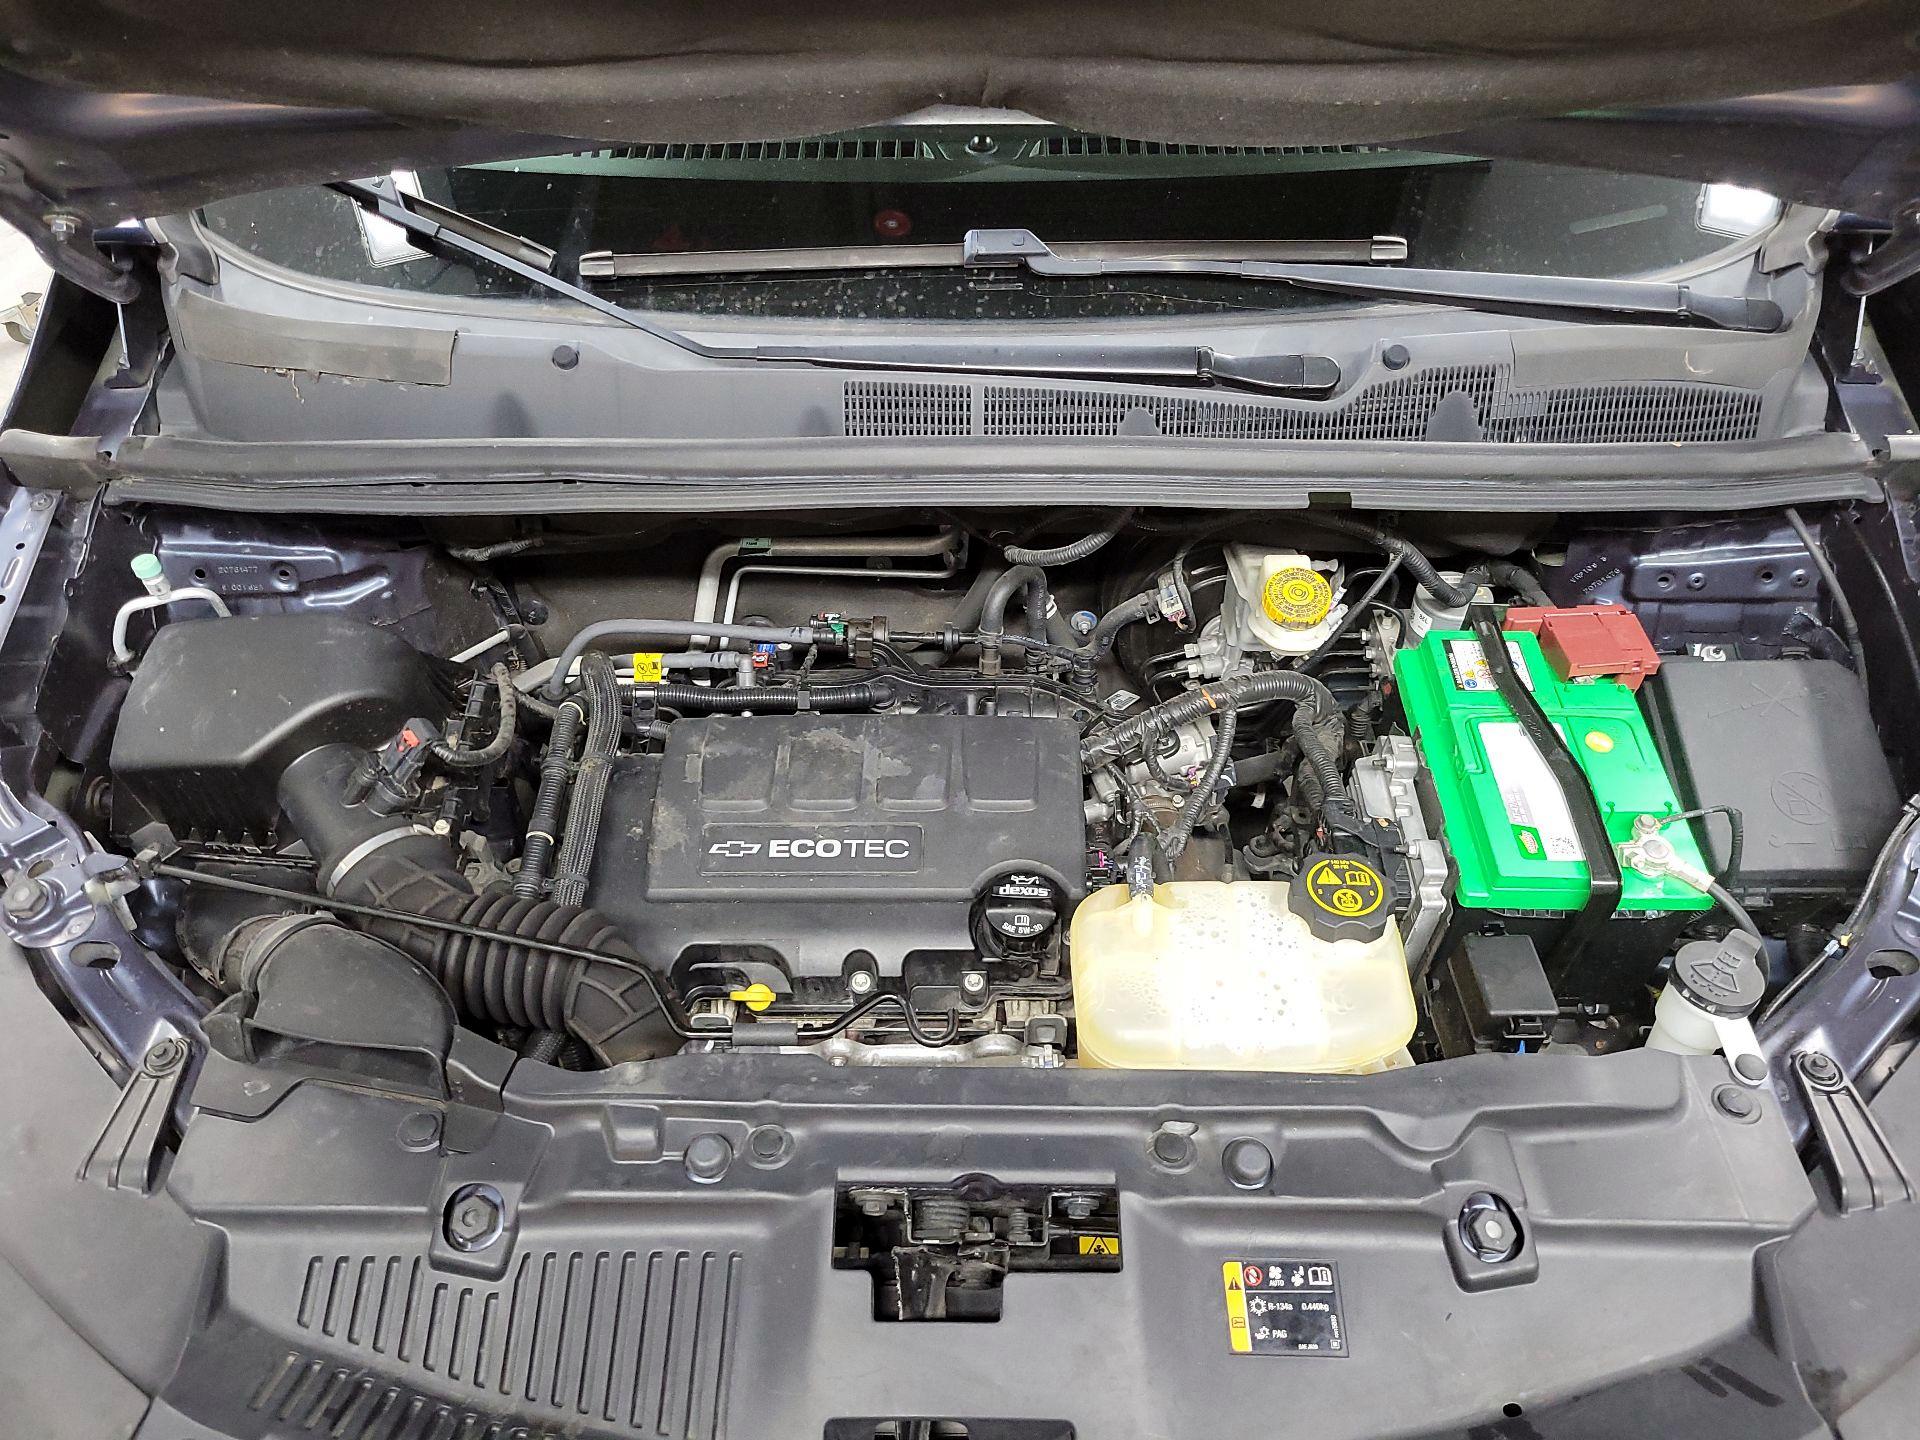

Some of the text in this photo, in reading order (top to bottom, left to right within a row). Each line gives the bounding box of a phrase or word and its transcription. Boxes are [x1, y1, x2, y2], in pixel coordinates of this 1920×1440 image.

[768, 839, 910, 858] ECOTEC
[999, 884, 1049, 897] dexos
[1002, 922, 1044, 935] SAE 5W-30
[1269, 1279, 1285, 1287] AUTO
[1267, 1302, 1294, 1311] R-134a
[1272, 1329, 1288, 1339] PAG
